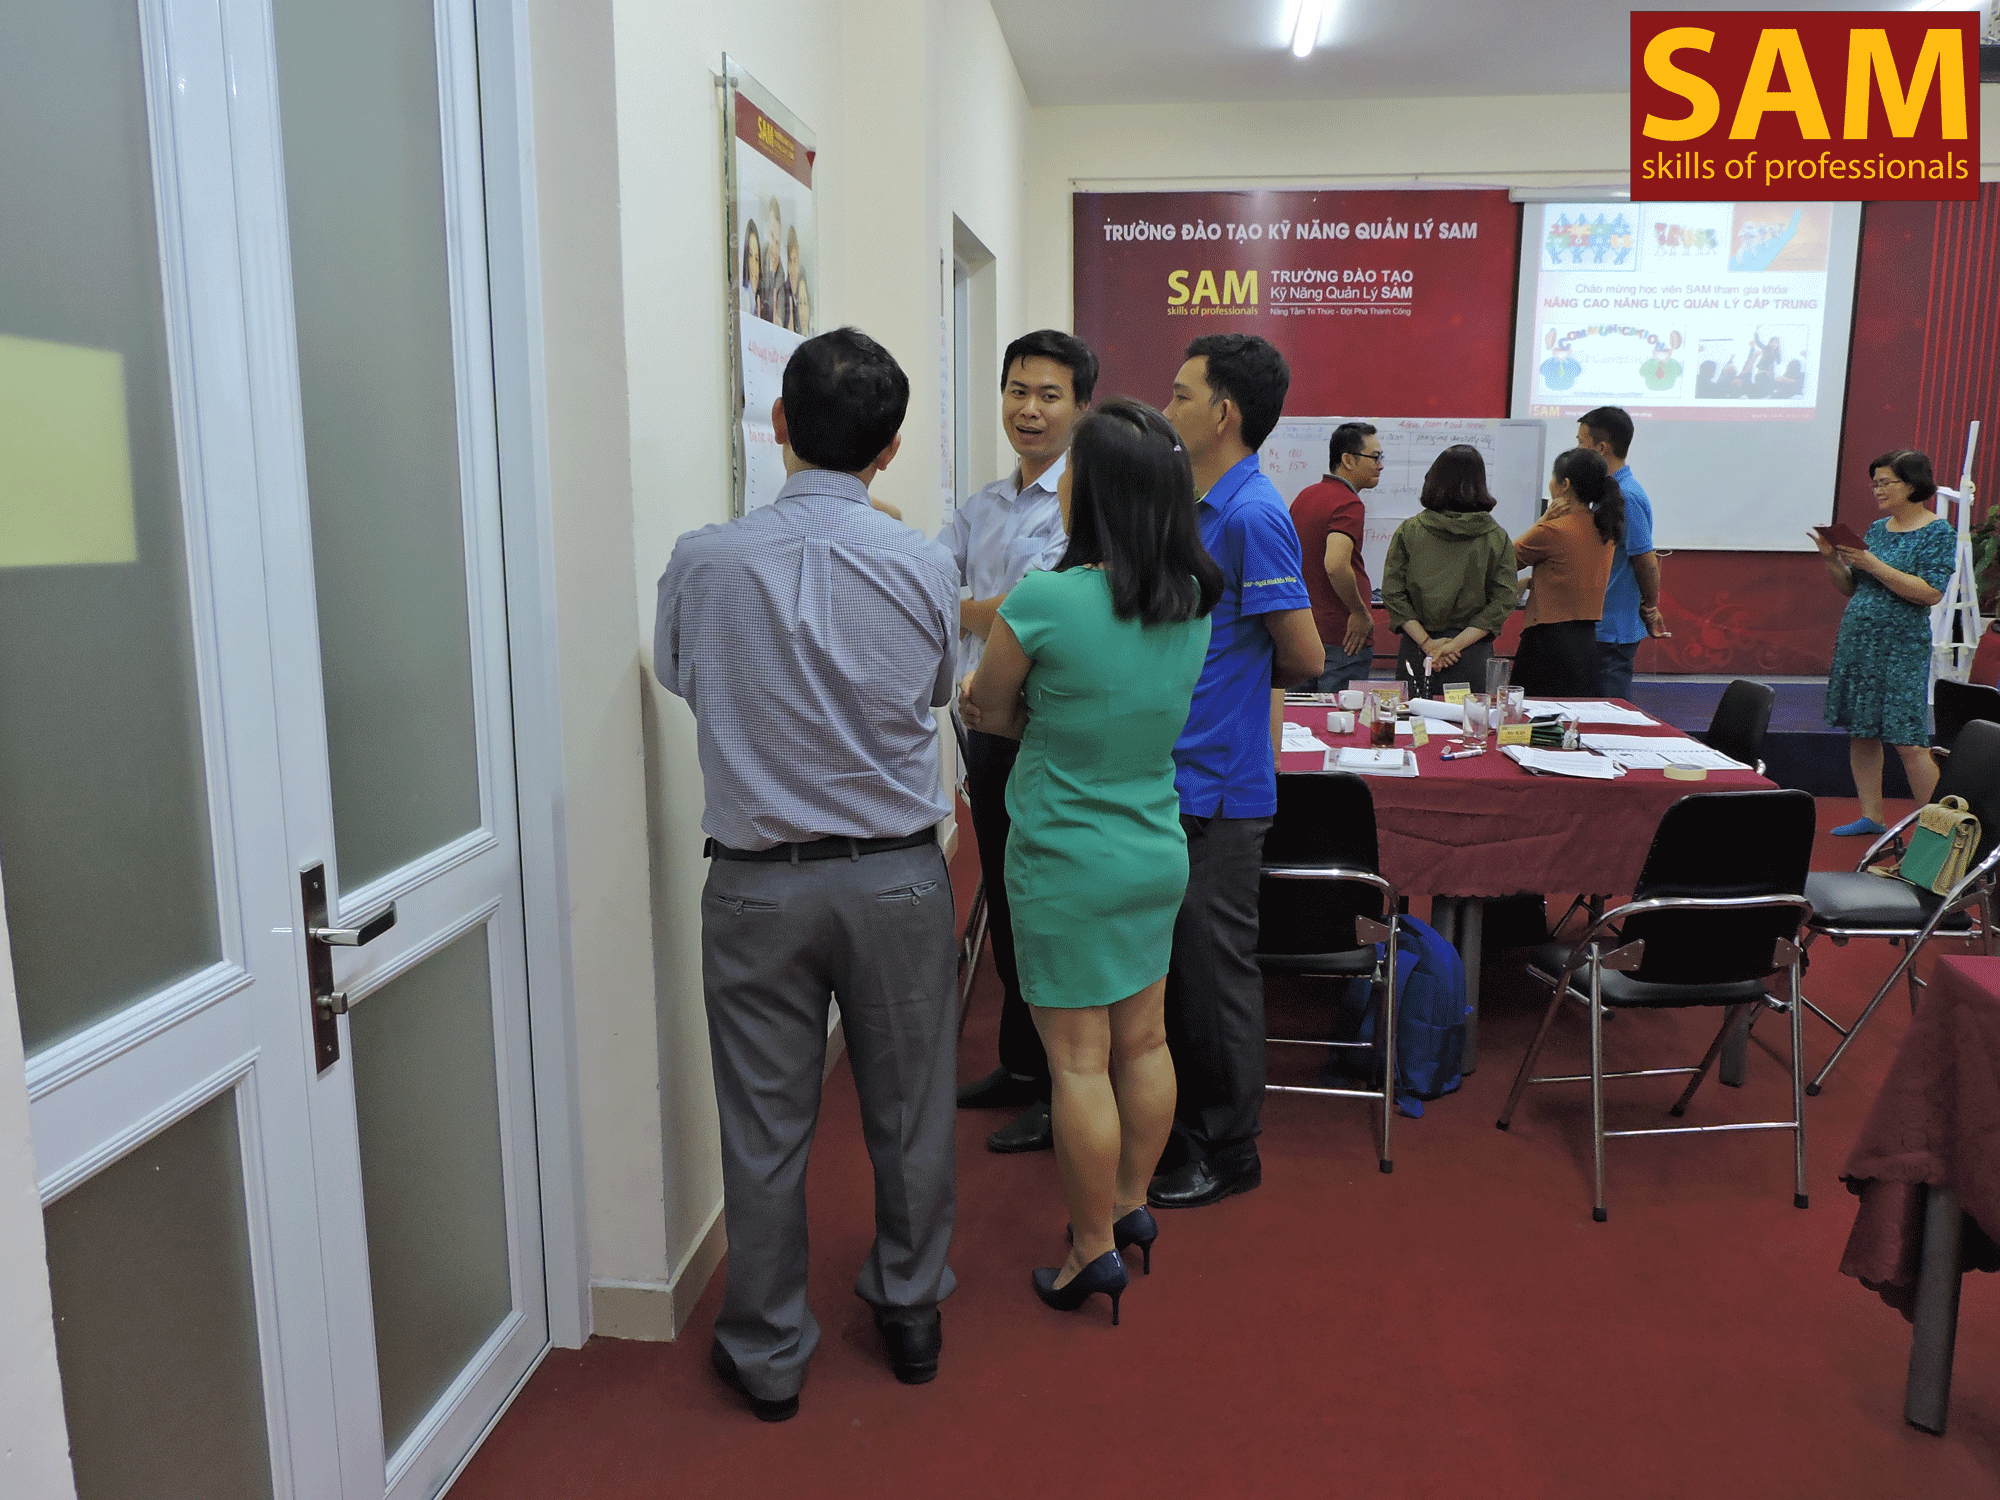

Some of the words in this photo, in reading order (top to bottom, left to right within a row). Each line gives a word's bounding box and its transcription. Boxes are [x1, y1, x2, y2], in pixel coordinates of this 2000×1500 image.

[1103, 219, 1176, 241] TRƯỜNG
[1181, 219, 1222, 240] ĐÀO
[1226, 223, 1263, 244] TẠO
[1268, 219, 1291, 240] KỸ
[1296, 219, 1350, 240] NĂNG
[1355, 217, 1409, 240] QUẢN
[1414, 218, 1434, 239] LÝ
[1438, 222, 1478, 239] SAM
[1270, 268, 1339, 283] TRƯỜNG
[1343, 267, 1377, 283] ĐÀO
[1381, 270, 1413, 285] TẠO
[1167, 269, 1259, 305] SAM
[1270, 286, 1287, 301] Kỹ
[1290, 286, 1323, 301] Năng
[1326, 286, 1360, 299] Quản
[1363, 286, 1378, 301] Lý
[1381, 286, 1413, 298] SAM
[1685, 285, 1712, 294] SAM
[1583, 298, 1610, 308] CAO
[1774, 299, 1818, 309] TRUNG
[1167, 306, 1188, 315] skills
[1190, 306, 1199, 315] of
[1201, 306, 1259, 316] professionals
[1532, 406, 1561, 417] SAM
